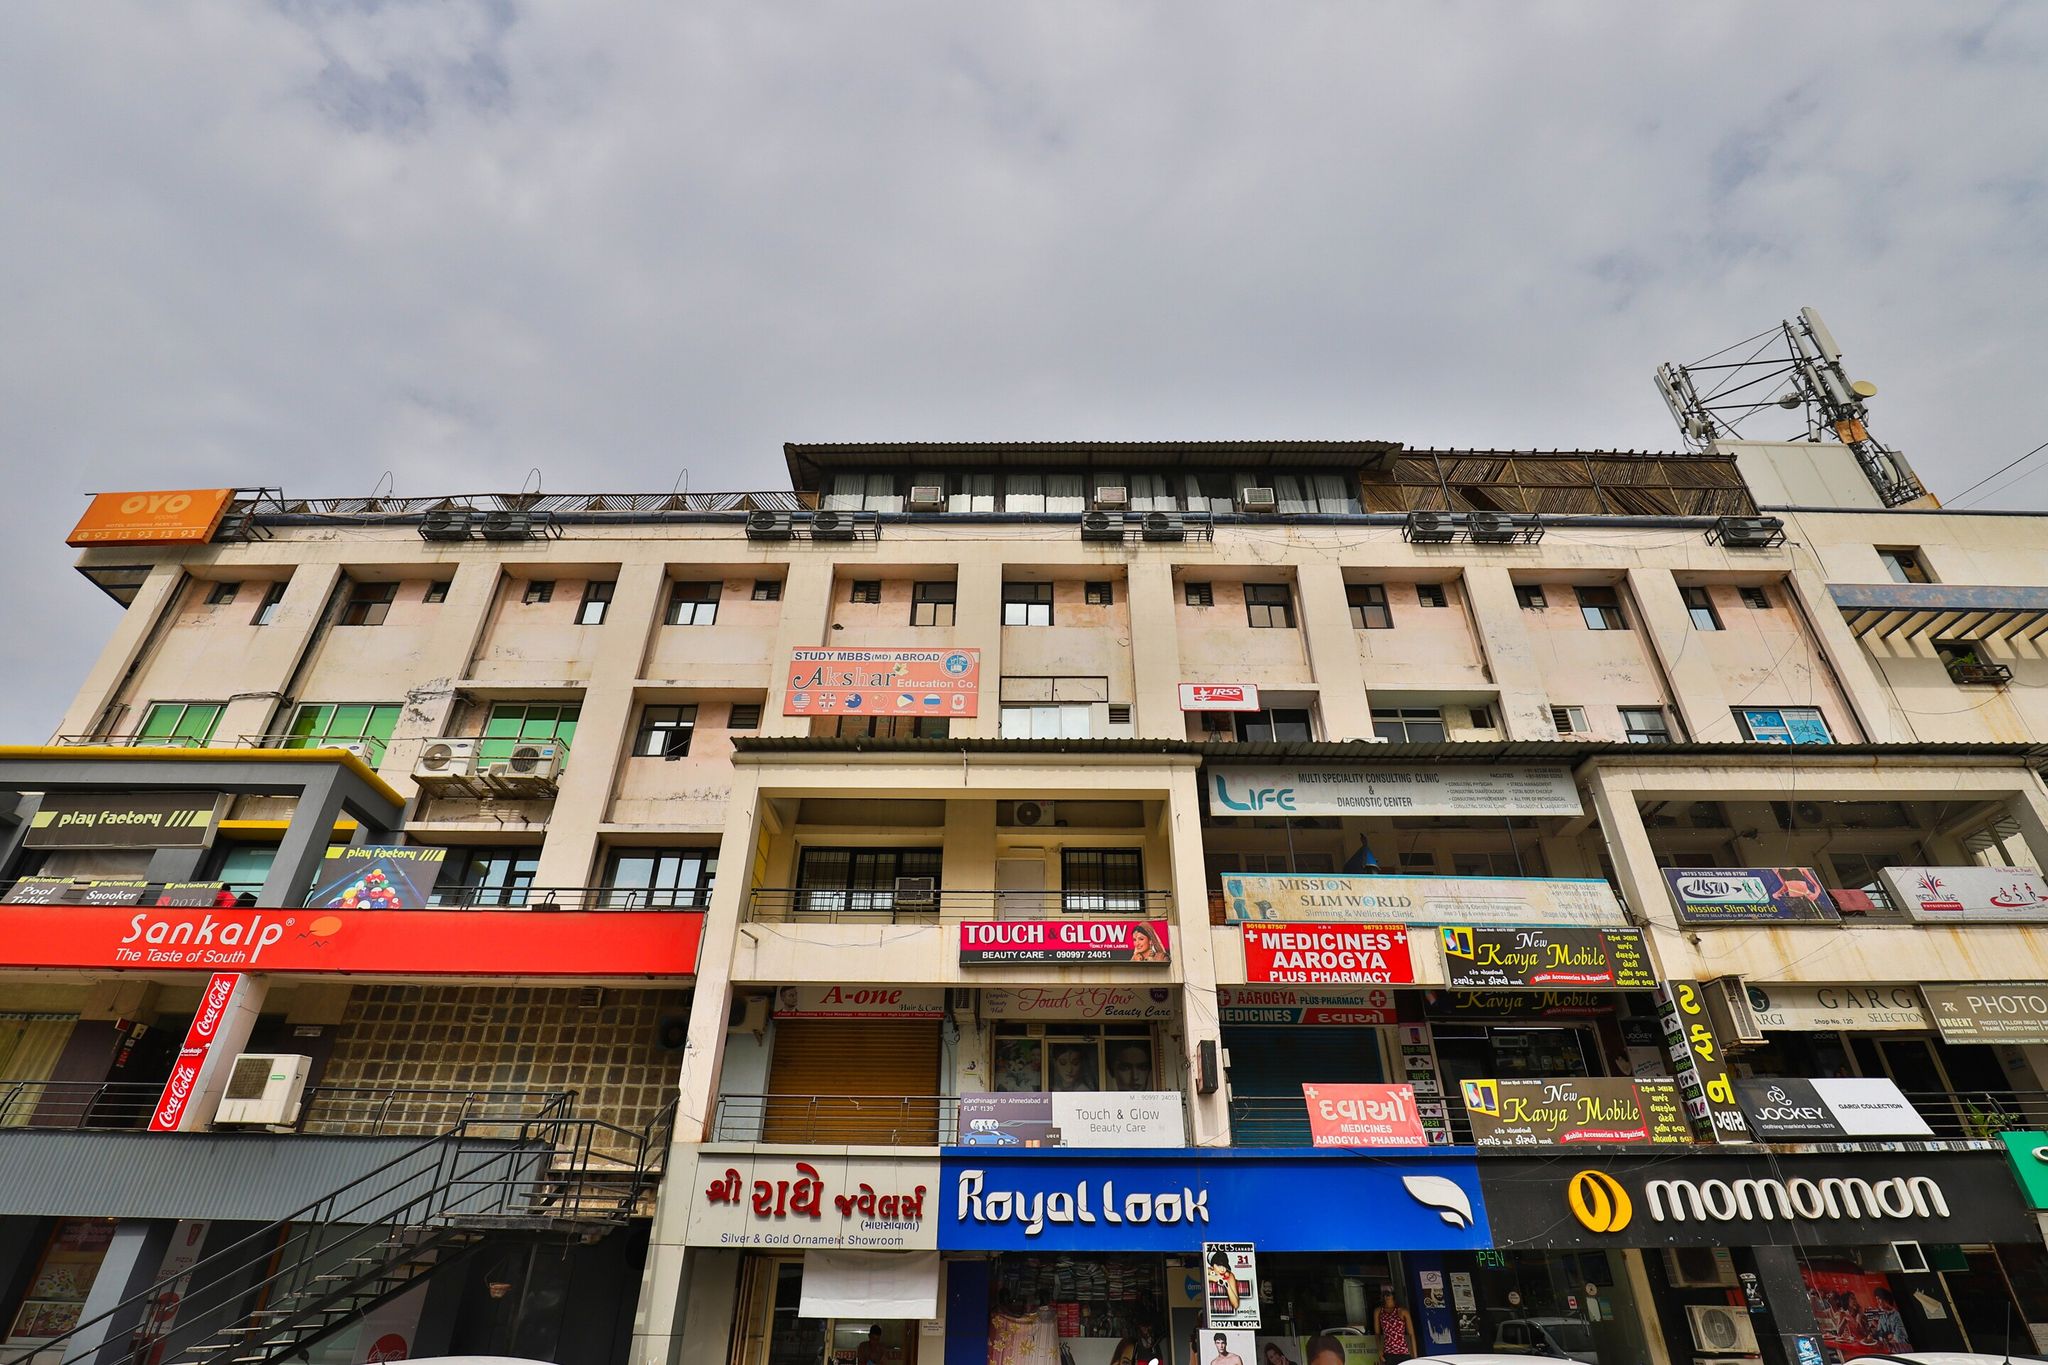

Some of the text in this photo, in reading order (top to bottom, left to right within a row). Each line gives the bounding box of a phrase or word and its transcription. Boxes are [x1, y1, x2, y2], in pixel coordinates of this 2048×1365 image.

[121, 494, 192, 514] OYO
[795, 652, 940, 661] STUDY MBBS(MD) ABROAD
[792, 666, 897, 690] Akshar
[897, 679, 977, 689] Education Co.
[1298, 773, 1440, 783] MULTI SPECIALITY CONSULTING CLINIC
[1368, 785, 1375, 795] &
[1337, 797, 1413, 808] DIAGNOSTIC CENTER
[58, 811, 164, 828] play factory
[347, 848, 416, 860] play factory
[19, 885, 57, 896] Pool
[1279, 880, 1353, 891] MISSION
[86, 890, 137, 901] Snooker
[1301, 896, 1412, 908] SLIM WORLD
[1305, 909, 1344, 918] Slimming
[1352, 910, 1391, 918] Wellness
[1687, 904, 1778, 914] Mission Slim World
[121, 913, 284, 964] Sankalp
[964, 924, 1128, 944] TOUCH & GLOW
[1515, 931, 1548, 949] New
[1262, 933, 1392, 951] MEDICINES
[115, 949, 246, 963] The Taste of South
[982, 951, 1111, 959] BEAUTY CARE 090997 24051
[1272, 952, 1387, 969] AAROGYA
[1477, 944, 1606, 974] Kavya Mobile
[1269, 972, 1392, 983] PLUS PHARMACY
[1552, 973, 1580, 982] Accessories
[1586, 973, 1610, 982] Repairing
[819, 985, 904, 1005] A-one
[1238, 992, 1365, 1006] AAROGYA PLUS PHARMACY
[1817, 988, 1926, 1010] GARGI
[196, 978, 232, 1037] Coca-Cola
[1105, 1005, 1172, 1017] Beauty Care
[1967, 995, 2048, 1014] PHOTO
[1318, 1010, 1385, 1025] દવાઓ
[1814, 1018, 1829, 1026] Shop
[1867, 1012, 1926, 1024] SELECTION
[1940, 1018, 1974, 1027] URGENT
[158, 1064, 196, 1128] Coca-Cola
[1543, 1083, 1578, 1104] New
[1318, 1091, 1408, 1122] દવાઓ
[1076, 1109, 1160, 1121] Touch & Glow
[1503, 1097, 1640, 1132] Kavya Mobile
[1755, 1107, 1824, 1121] JOCKEY
[1090, 1123, 1146, 1134] Beauty Care
[1340, 1124, 1393, 1133] MEDICINES
[1316, 1136, 1361, 1145] AAROGYA
[1371, 1136, 1423, 1145] PHARMACY
[1564, 1132, 1583, 1141] Mobile
[1620, 1130, 1646, 1139] Repairing
[705, 1162, 928, 1218] શ્રી રાધે જવેલર્સ
[958, 1169, 1097, 1235] Royal
[1645, 1177, 1951, 1222] momoman
[720, 1232, 905, 1246] Silver & Gold Ornament Showroom
[1237, 1255, 1249, 1265] 31
